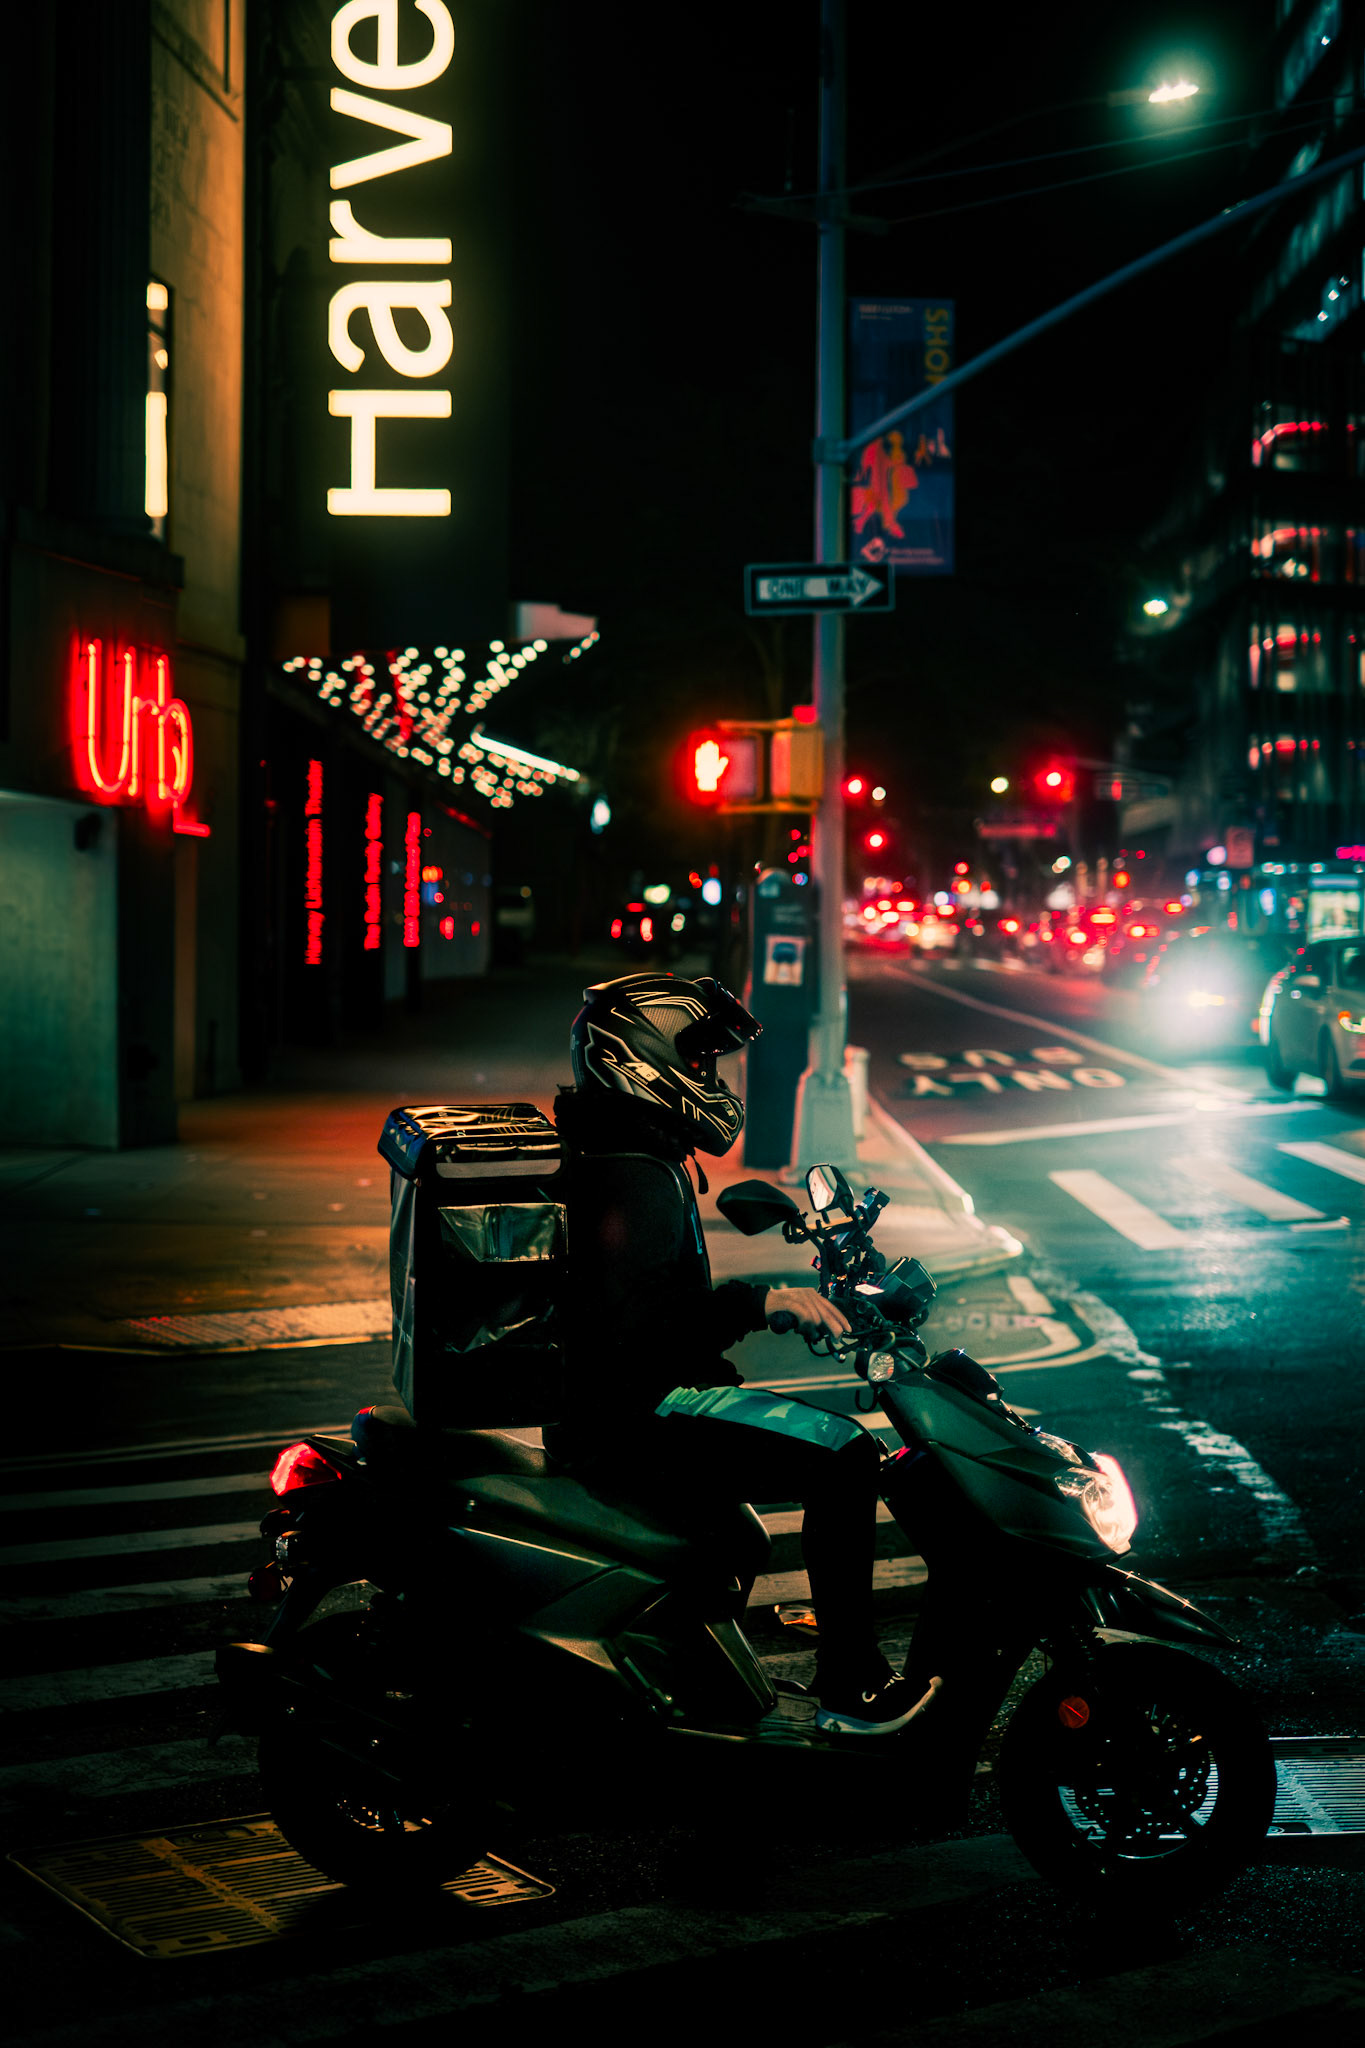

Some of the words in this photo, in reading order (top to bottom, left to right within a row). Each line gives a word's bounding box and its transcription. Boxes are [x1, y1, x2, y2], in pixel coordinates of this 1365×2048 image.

[327, 0, 455, 517] Harve
[769, 577, 804, 600] ONE
[826, 575, 868, 597] WAY
[913, 1067, 1126, 1097] ONLY
